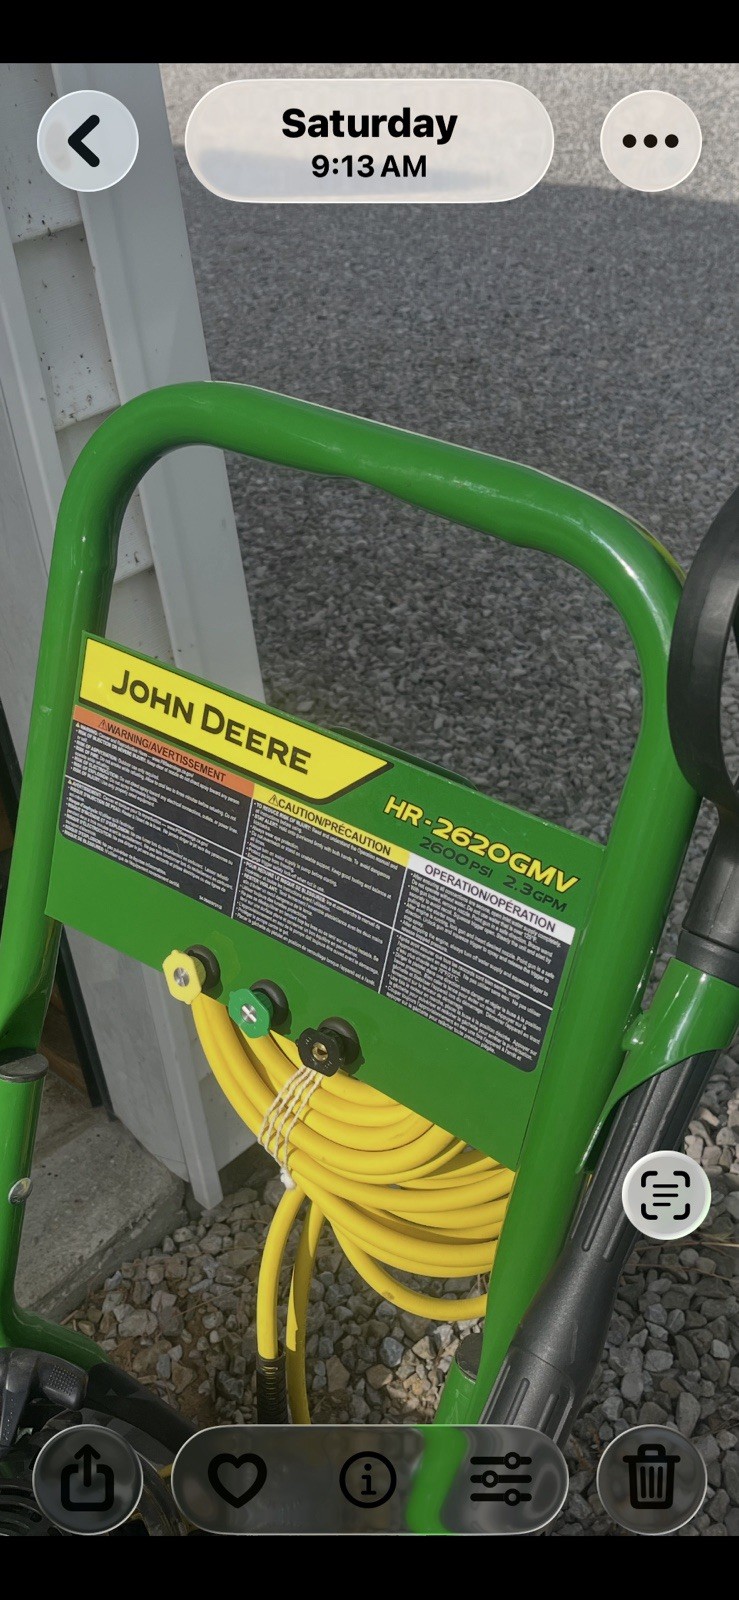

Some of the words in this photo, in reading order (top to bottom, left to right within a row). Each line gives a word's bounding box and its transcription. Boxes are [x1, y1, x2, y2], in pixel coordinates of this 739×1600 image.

[106, 722, 227, 783] WARNING/AVERTISSEMENT
[111, 669, 195, 725] JOHN
[200, 703, 313, 775] DEERE
[278, 798, 392, 856] CAUTION/PRÉCAUTION
[424, 864, 556, 933] OPERATION/OPÉRATION
